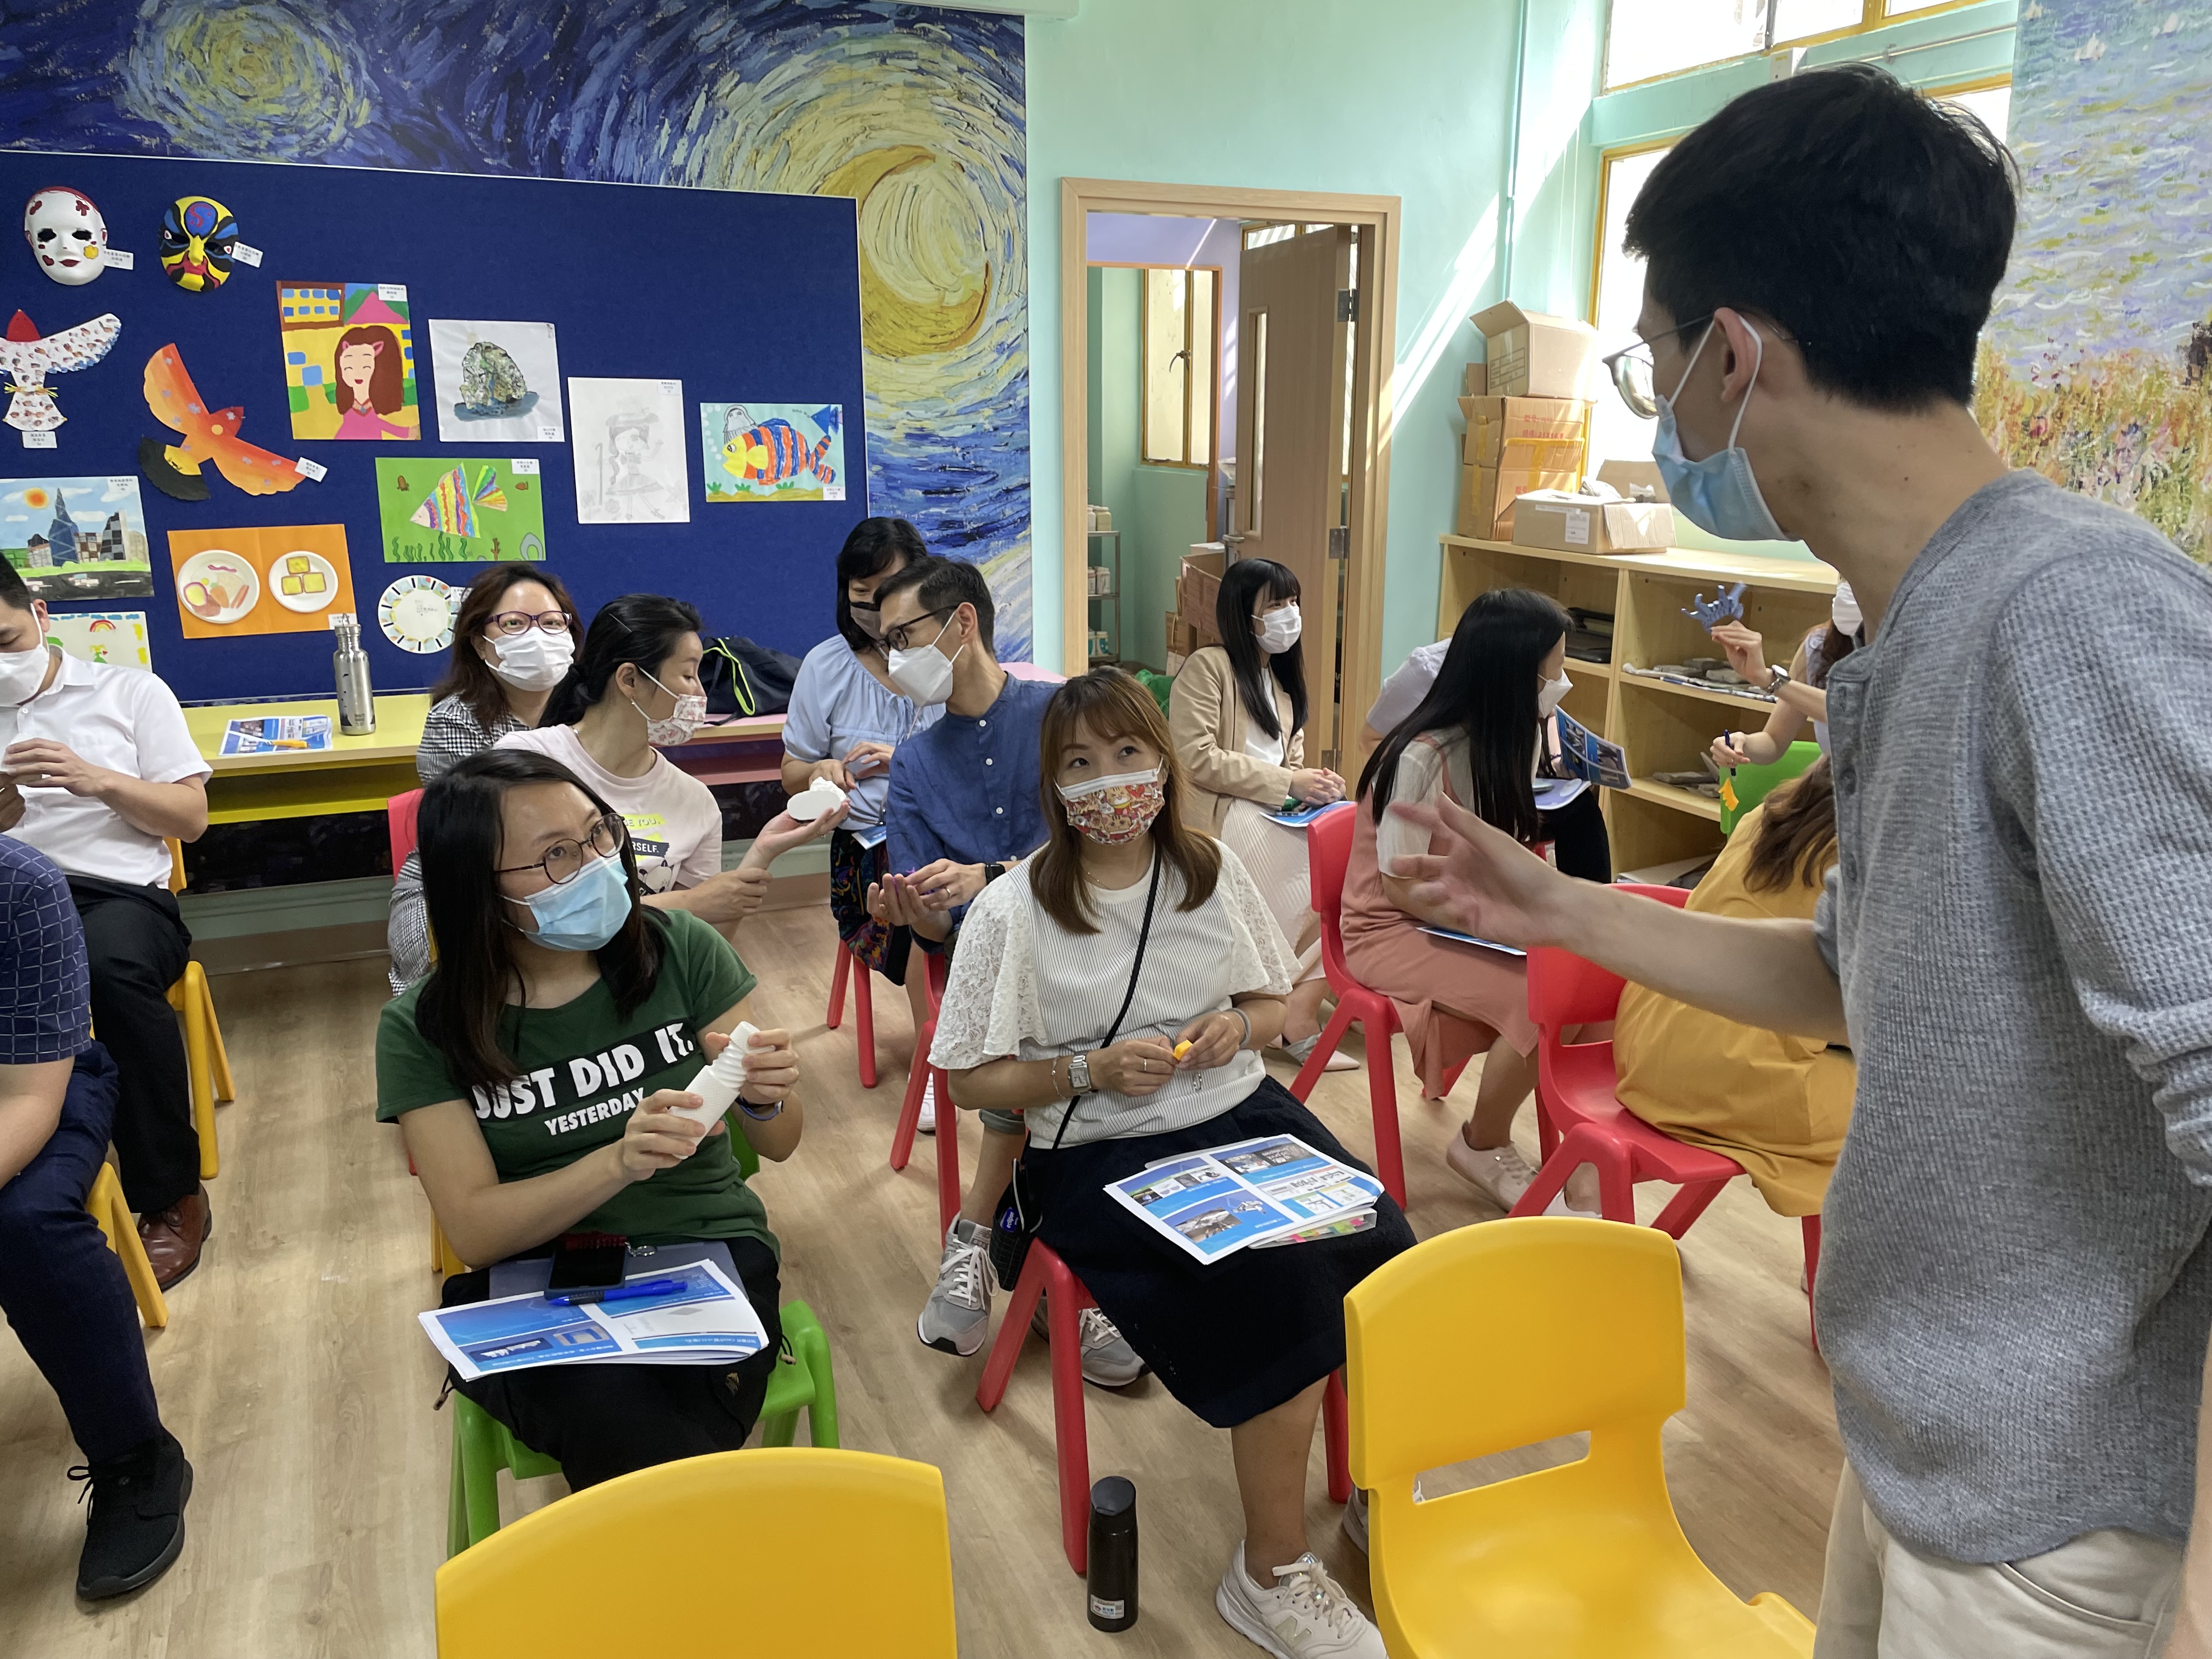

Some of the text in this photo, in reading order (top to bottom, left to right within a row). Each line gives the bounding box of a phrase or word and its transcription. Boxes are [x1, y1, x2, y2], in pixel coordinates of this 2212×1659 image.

[471, 1022, 695, 1119] JUST DID IT.
[544, 1087, 645, 1136] YESTERDAY
